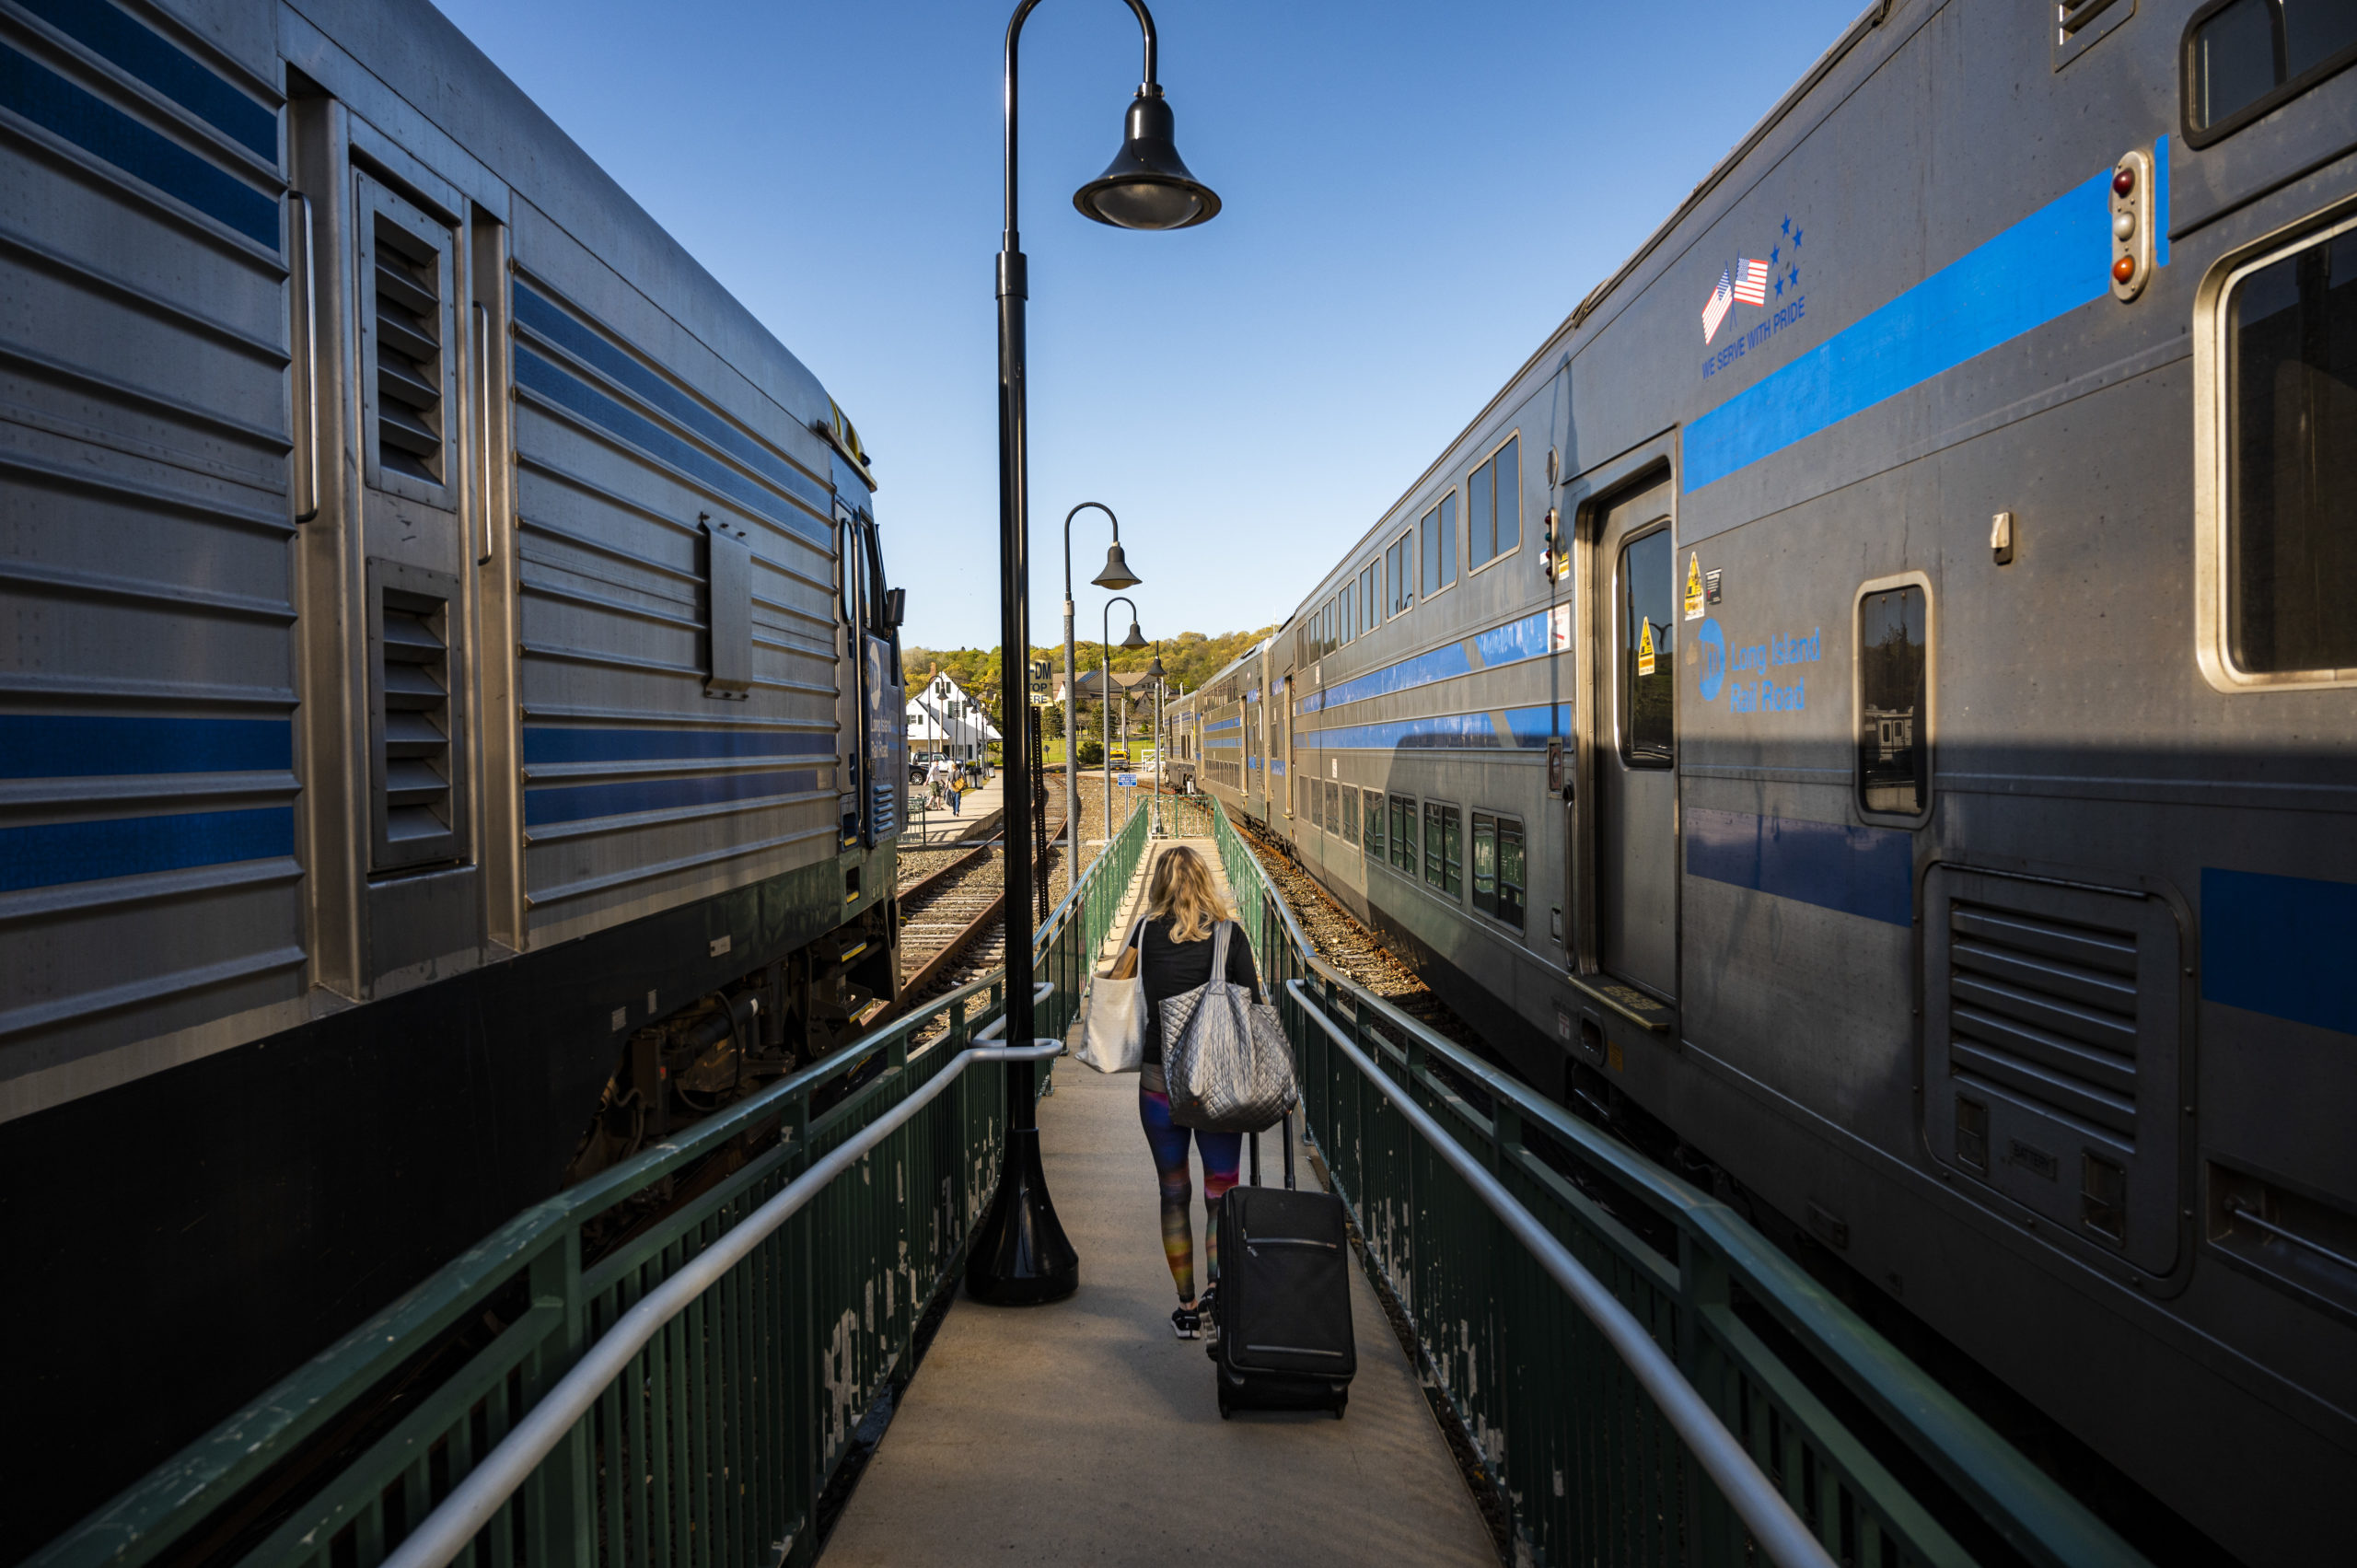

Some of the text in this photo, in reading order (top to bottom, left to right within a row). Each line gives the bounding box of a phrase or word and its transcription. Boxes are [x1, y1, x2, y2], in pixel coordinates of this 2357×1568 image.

[1701, 296, 1805, 379] WE SERVE WITH PRIDE
[1731, 626, 1820, 675] Long Island
[1029, 682, 1048, 692] OP
[1730, 677, 1805, 713] Rail Road
[870, 714, 880, 737] Long
[2013, 1143, 2049, 1172] BATTERY
